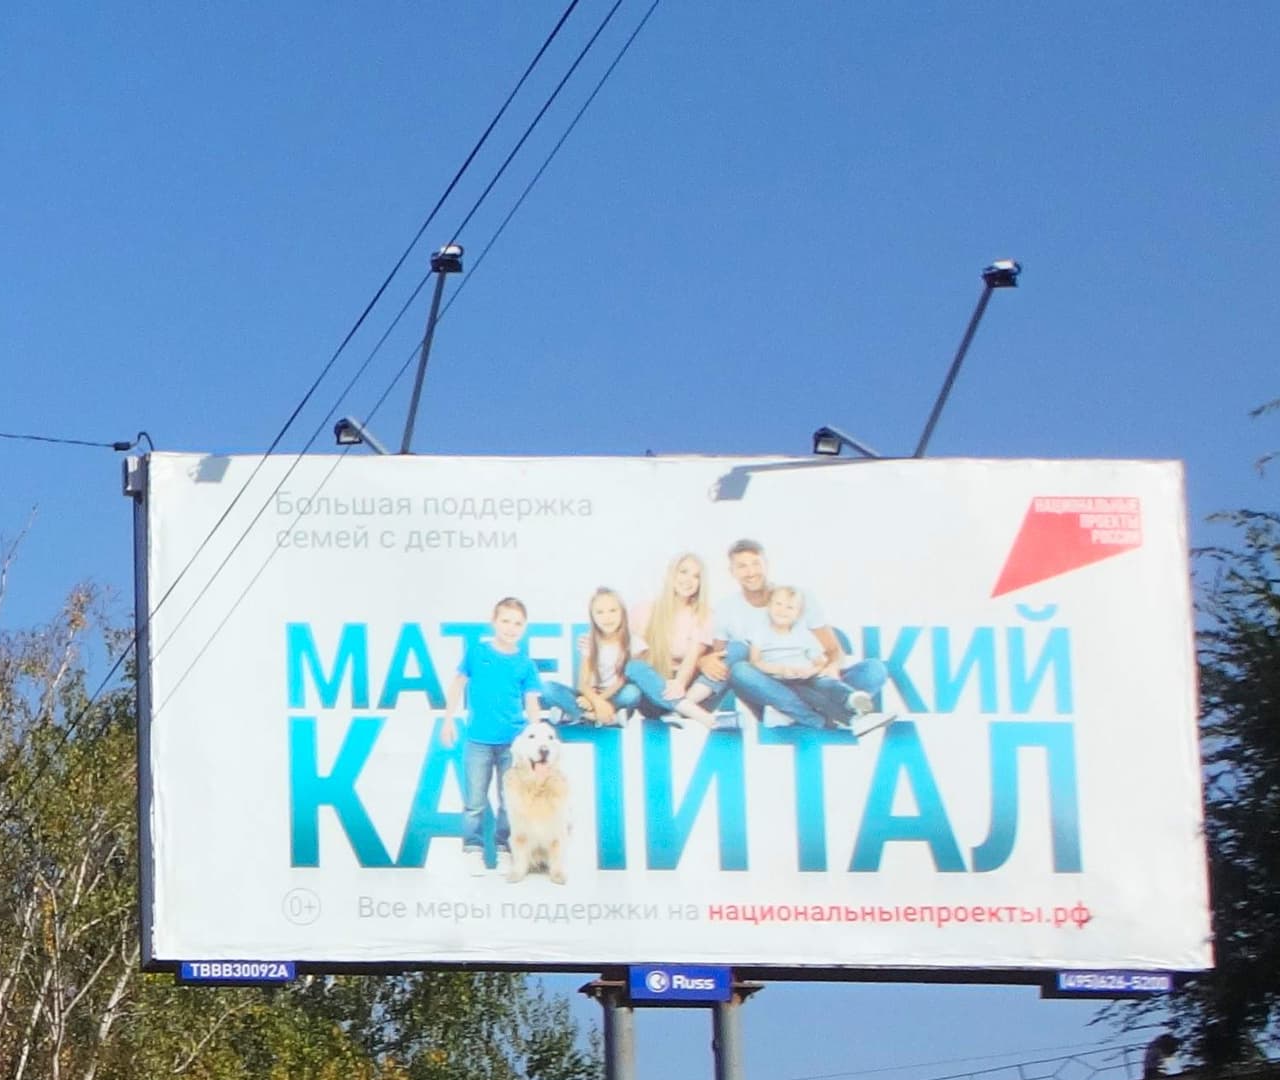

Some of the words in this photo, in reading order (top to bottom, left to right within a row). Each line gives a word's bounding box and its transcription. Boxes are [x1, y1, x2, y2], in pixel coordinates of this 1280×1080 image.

[275, 491, 412, 515] Большая
[424, 496, 593, 520] поддержка
[275, 525, 369, 549] семей
[379, 530, 396, 549] с
[405, 529, 518, 552] детьми
[286, 604, 1073, 712] МАТЕКИЙ
[288, 716, 1083, 873] КАПИТАЛ
[358, 896, 407, 918] Все
[416, 902, 491, 922] меры
[501, 902, 659, 922] поддержки
[669, 904, 700, 920] на
[708, 902, 1092, 929] национальныепроекты.рф
[672, 975, 715, 990] Russ
